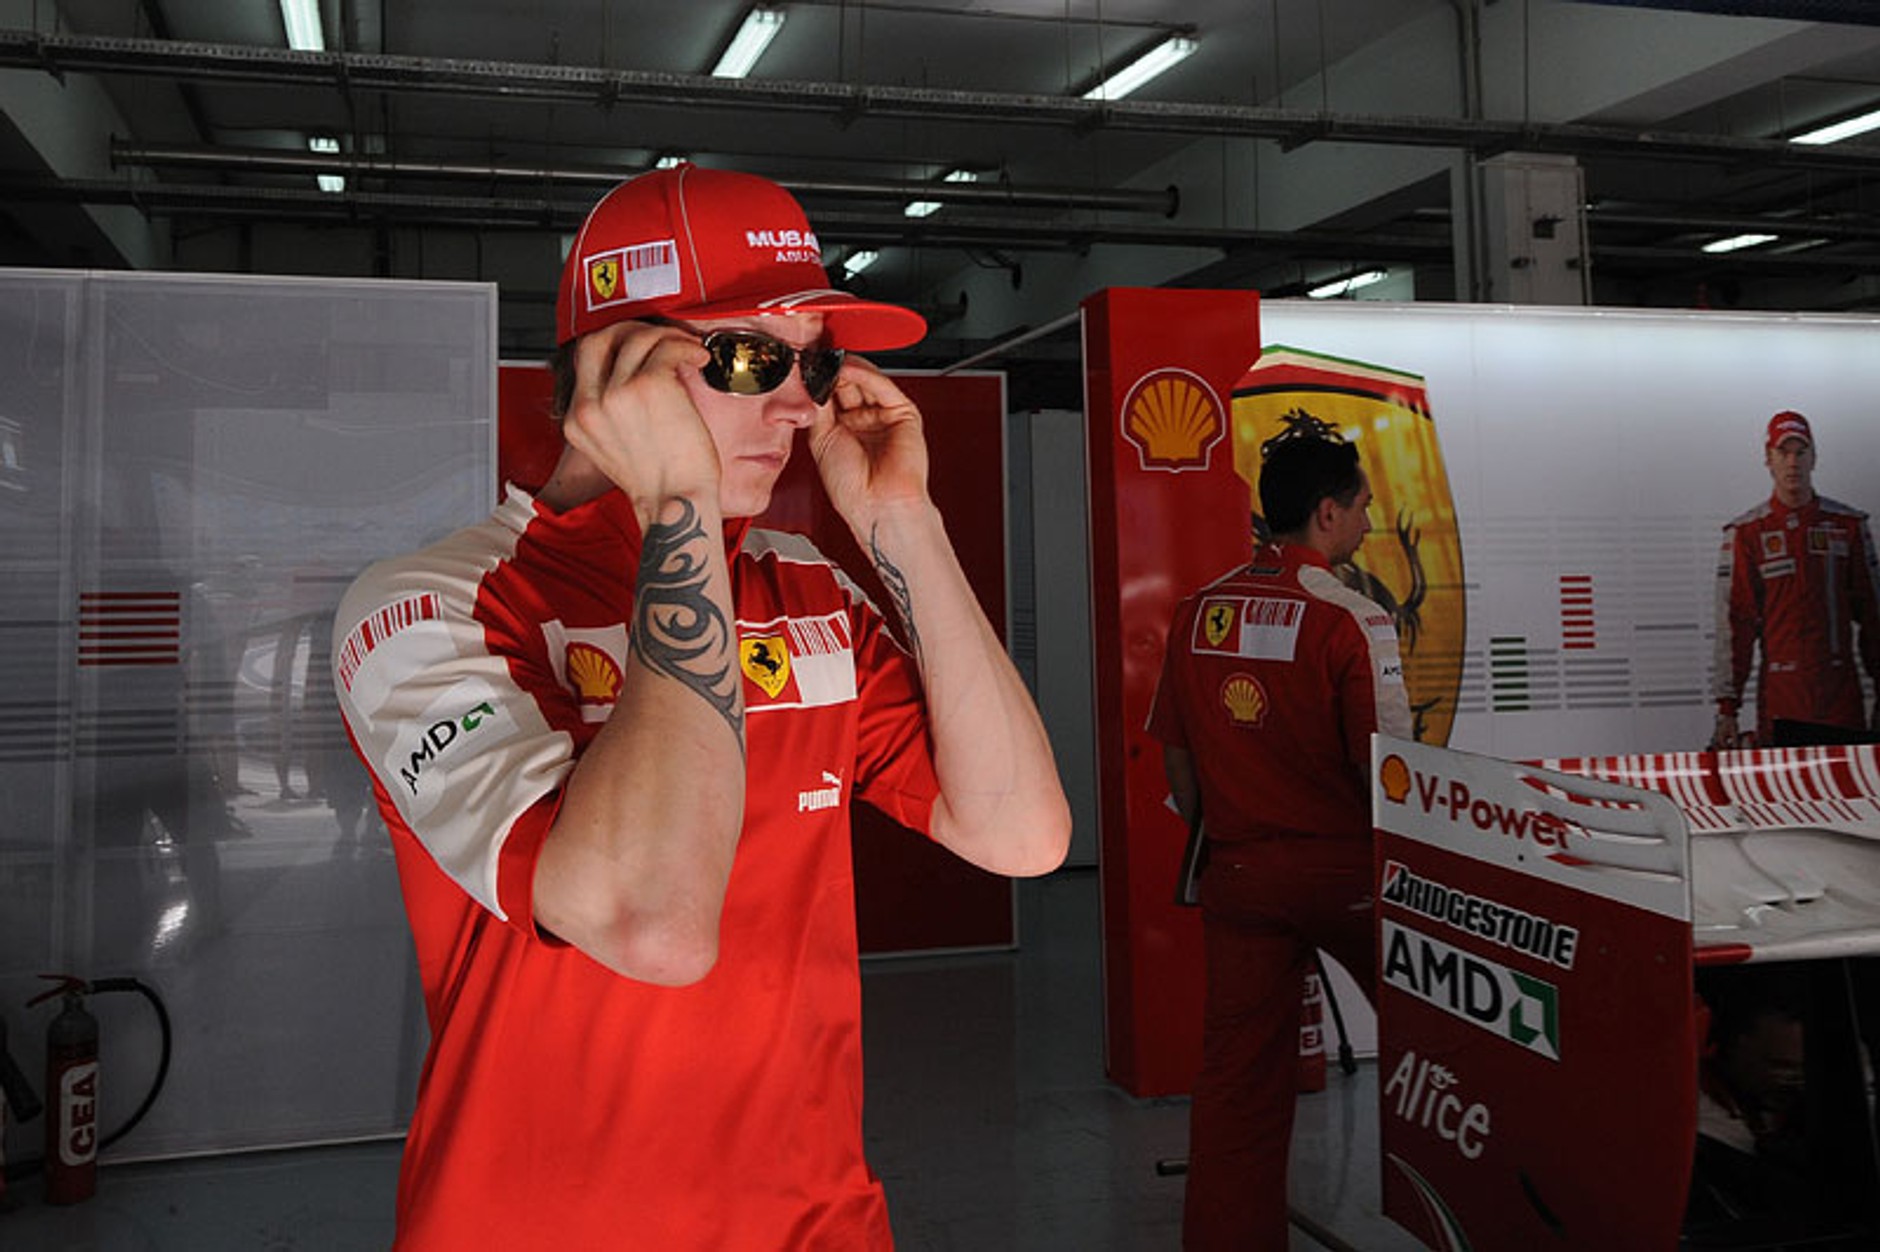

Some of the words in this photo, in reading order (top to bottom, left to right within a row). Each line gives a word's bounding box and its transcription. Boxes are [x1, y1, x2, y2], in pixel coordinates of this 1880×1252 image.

[401, 720, 457, 795] AMD
[798, 787, 840, 812] PUMA
[1414, 771, 1570, 849] V-Power
[1383, 866, 1575, 965] BRIDGESTONE
[1386, 930, 1502, 1022] AMD
[69, 1071, 96, 1156] CEA
[1384, 1050, 1491, 1160] Alice
